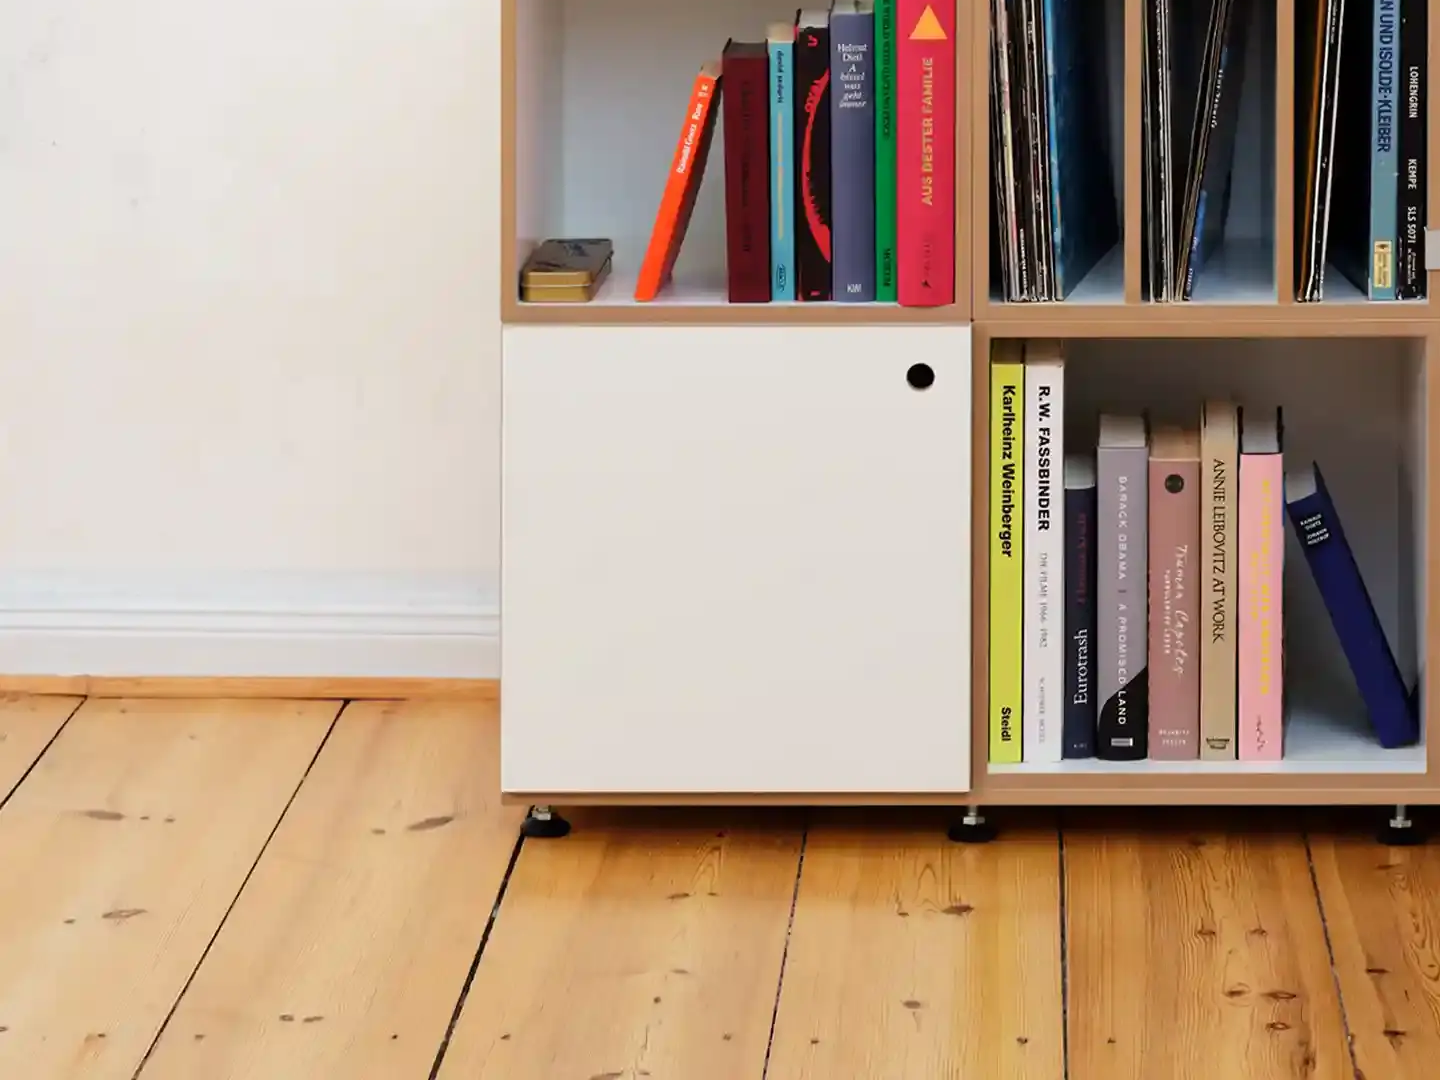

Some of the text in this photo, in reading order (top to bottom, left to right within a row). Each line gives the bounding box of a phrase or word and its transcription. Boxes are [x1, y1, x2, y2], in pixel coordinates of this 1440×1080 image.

[1379, 13, 1394, 44] UND
[1408, 66, 1419, 119] LOHENGRIN
[921, 176, 933, 206] AUS
[1407, 158, 1418, 191] KEMPE
[1407, 206, 1417, 221] SLS
[998, 385, 1016, 557] Karlheinz Weinberger
[1037, 386, 1051, 531] R.W. FASSBINDER
[1118, 534, 1128, 580] OBAMA
[1212, 458, 1226, 644] ANNIE LEIBOVITZ AT WORK
[1073, 628, 1088, 705] Eurotrash
[1001, 707, 1012, 741] Steidl
[1117, 691, 1127, 725] LAND
